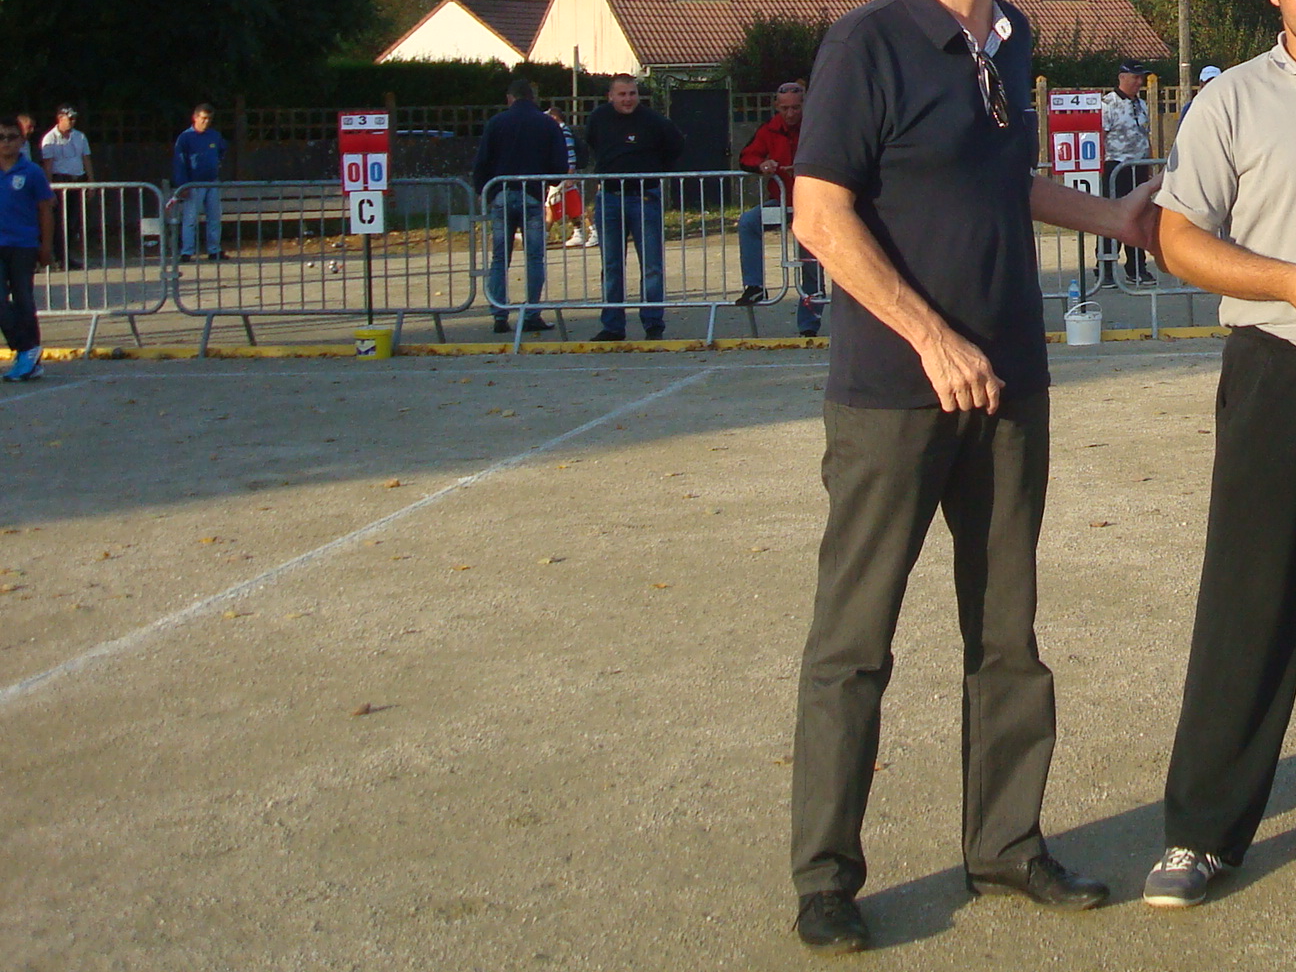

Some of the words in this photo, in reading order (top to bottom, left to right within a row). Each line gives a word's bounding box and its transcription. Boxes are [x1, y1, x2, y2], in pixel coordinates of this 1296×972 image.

[1070, 95, 1080, 106] 4
[358, 116, 367, 126] 3
[358, 198, 375, 224] C
